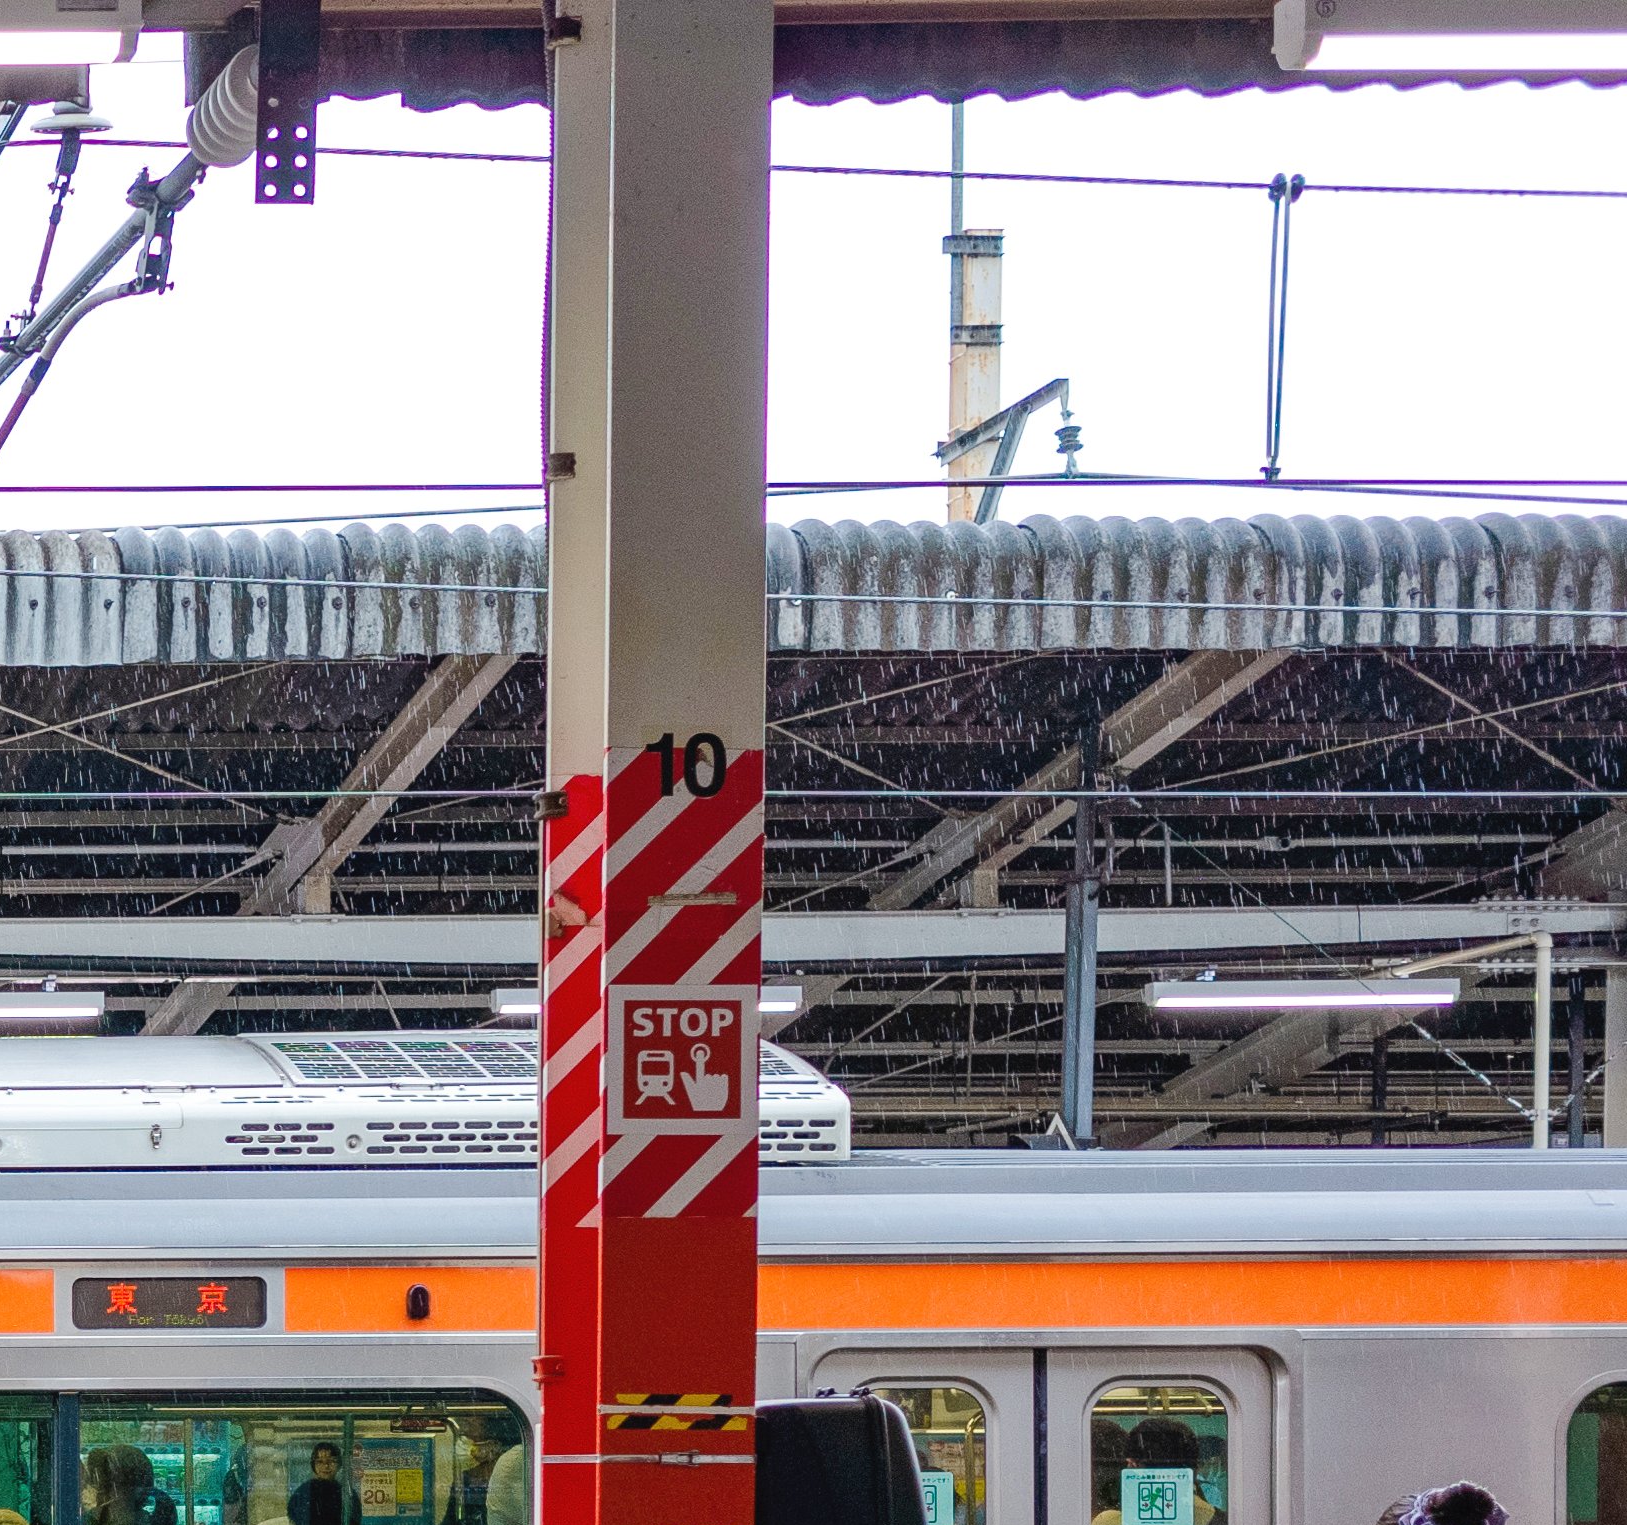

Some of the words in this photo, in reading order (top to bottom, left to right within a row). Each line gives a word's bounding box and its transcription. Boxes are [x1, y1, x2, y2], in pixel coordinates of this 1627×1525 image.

[645, 731, 728, 798] 10
[632, 1006, 735, 1038] STOP
[106, 1282, 228, 1315] 東京
[128, 1314, 154, 1326] For
